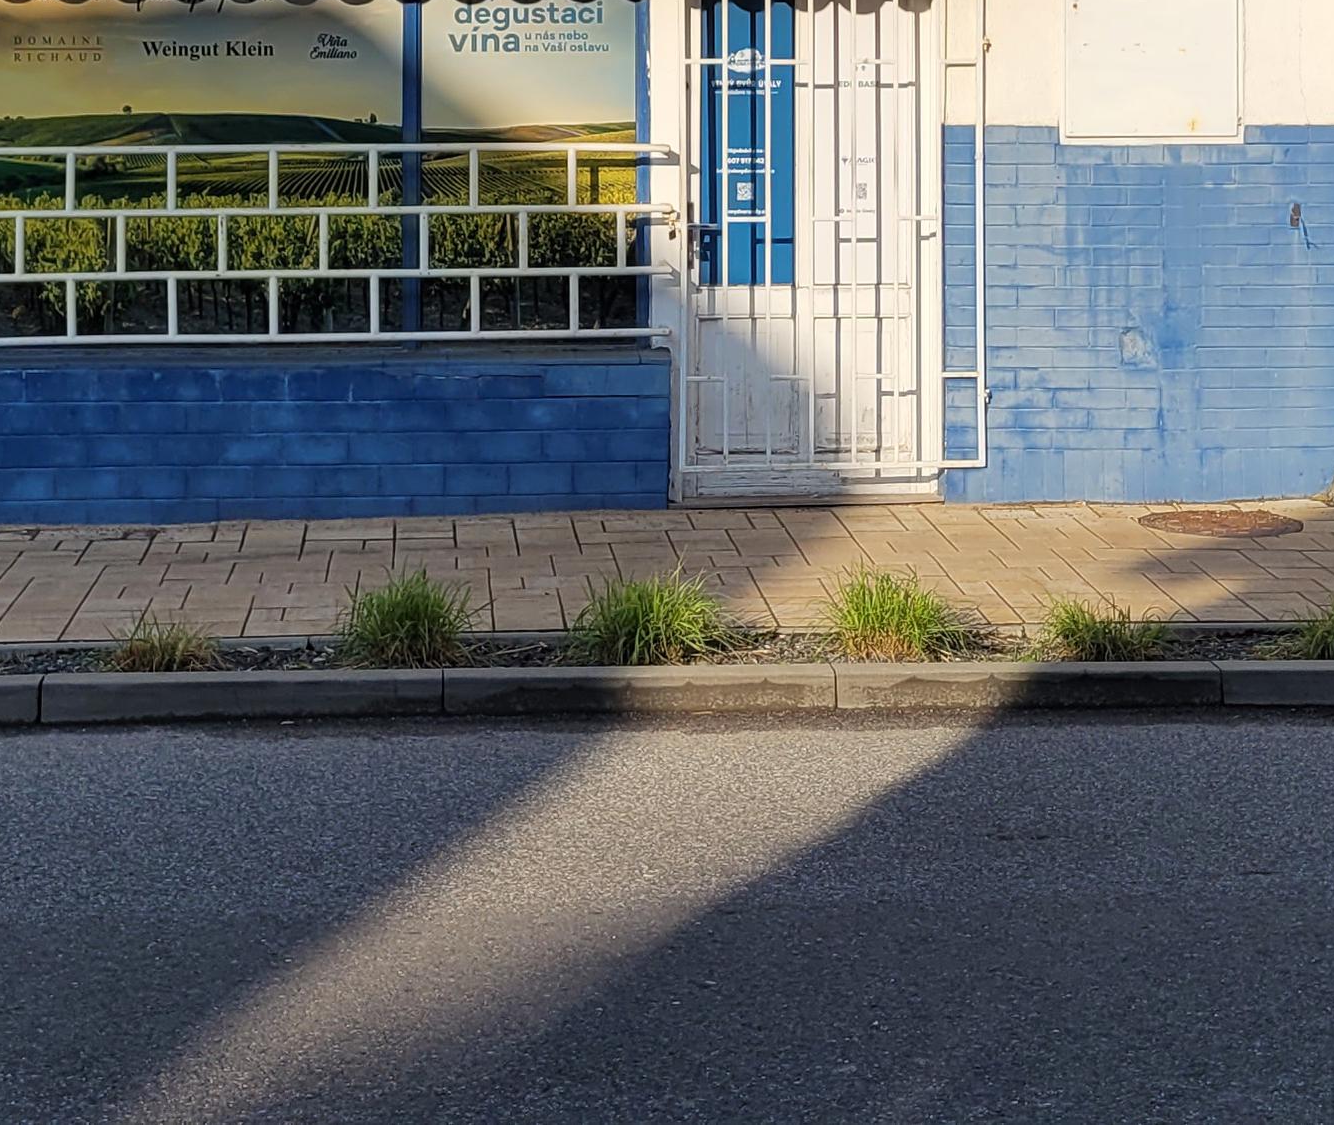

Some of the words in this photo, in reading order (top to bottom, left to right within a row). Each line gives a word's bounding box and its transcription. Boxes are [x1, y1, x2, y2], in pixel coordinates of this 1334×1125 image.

[454, 0, 603, 31] degustaci
[448, 26, 520, 53] vína
[535, 30, 556, 40] nás
[558, 30, 589, 40] nebo
[142, 41, 219, 61] Weingut
[226, 41, 274, 57] Klein
[524, 44, 539, 52] na
[542, 41, 568, 52] Vaší
[569, 41, 610, 52] oslavu
[13, 53, 102, 62] RICHAUD
